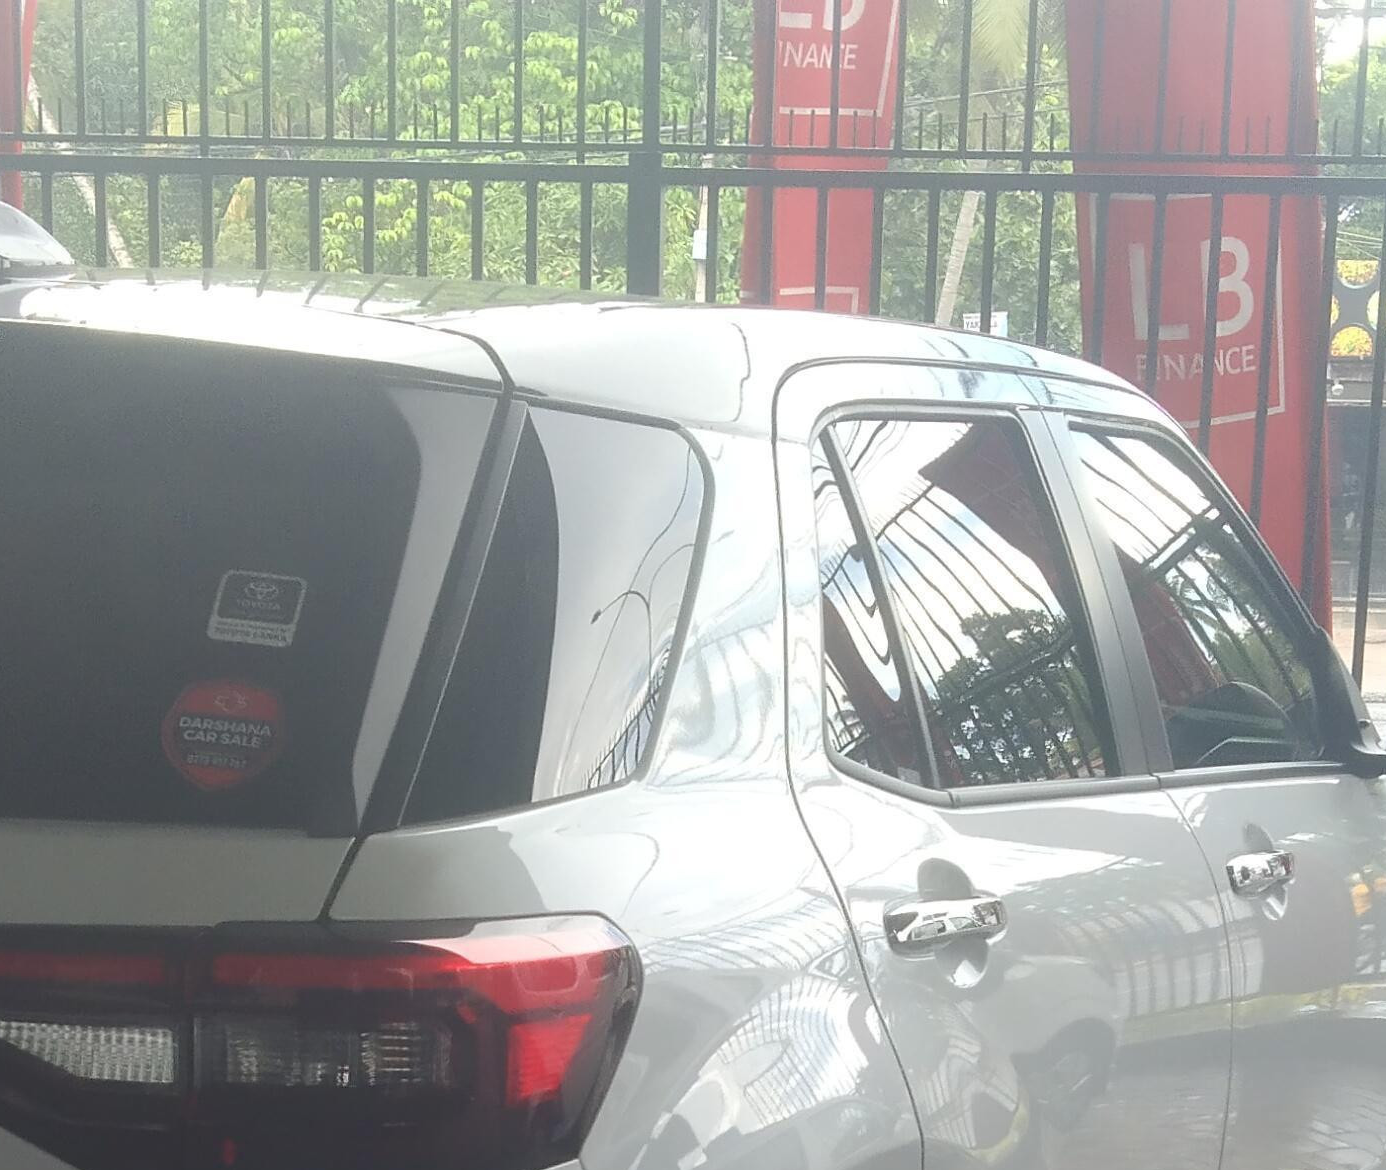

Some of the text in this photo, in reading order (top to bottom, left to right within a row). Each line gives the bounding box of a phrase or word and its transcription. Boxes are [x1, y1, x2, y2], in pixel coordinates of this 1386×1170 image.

[1128, 236, 1254, 341] LB
[1134, 344, 1257, 382] FNANCE
[178, 716, 272, 737] DARSHANA
[182, 729, 263, 749] CAR SALE
